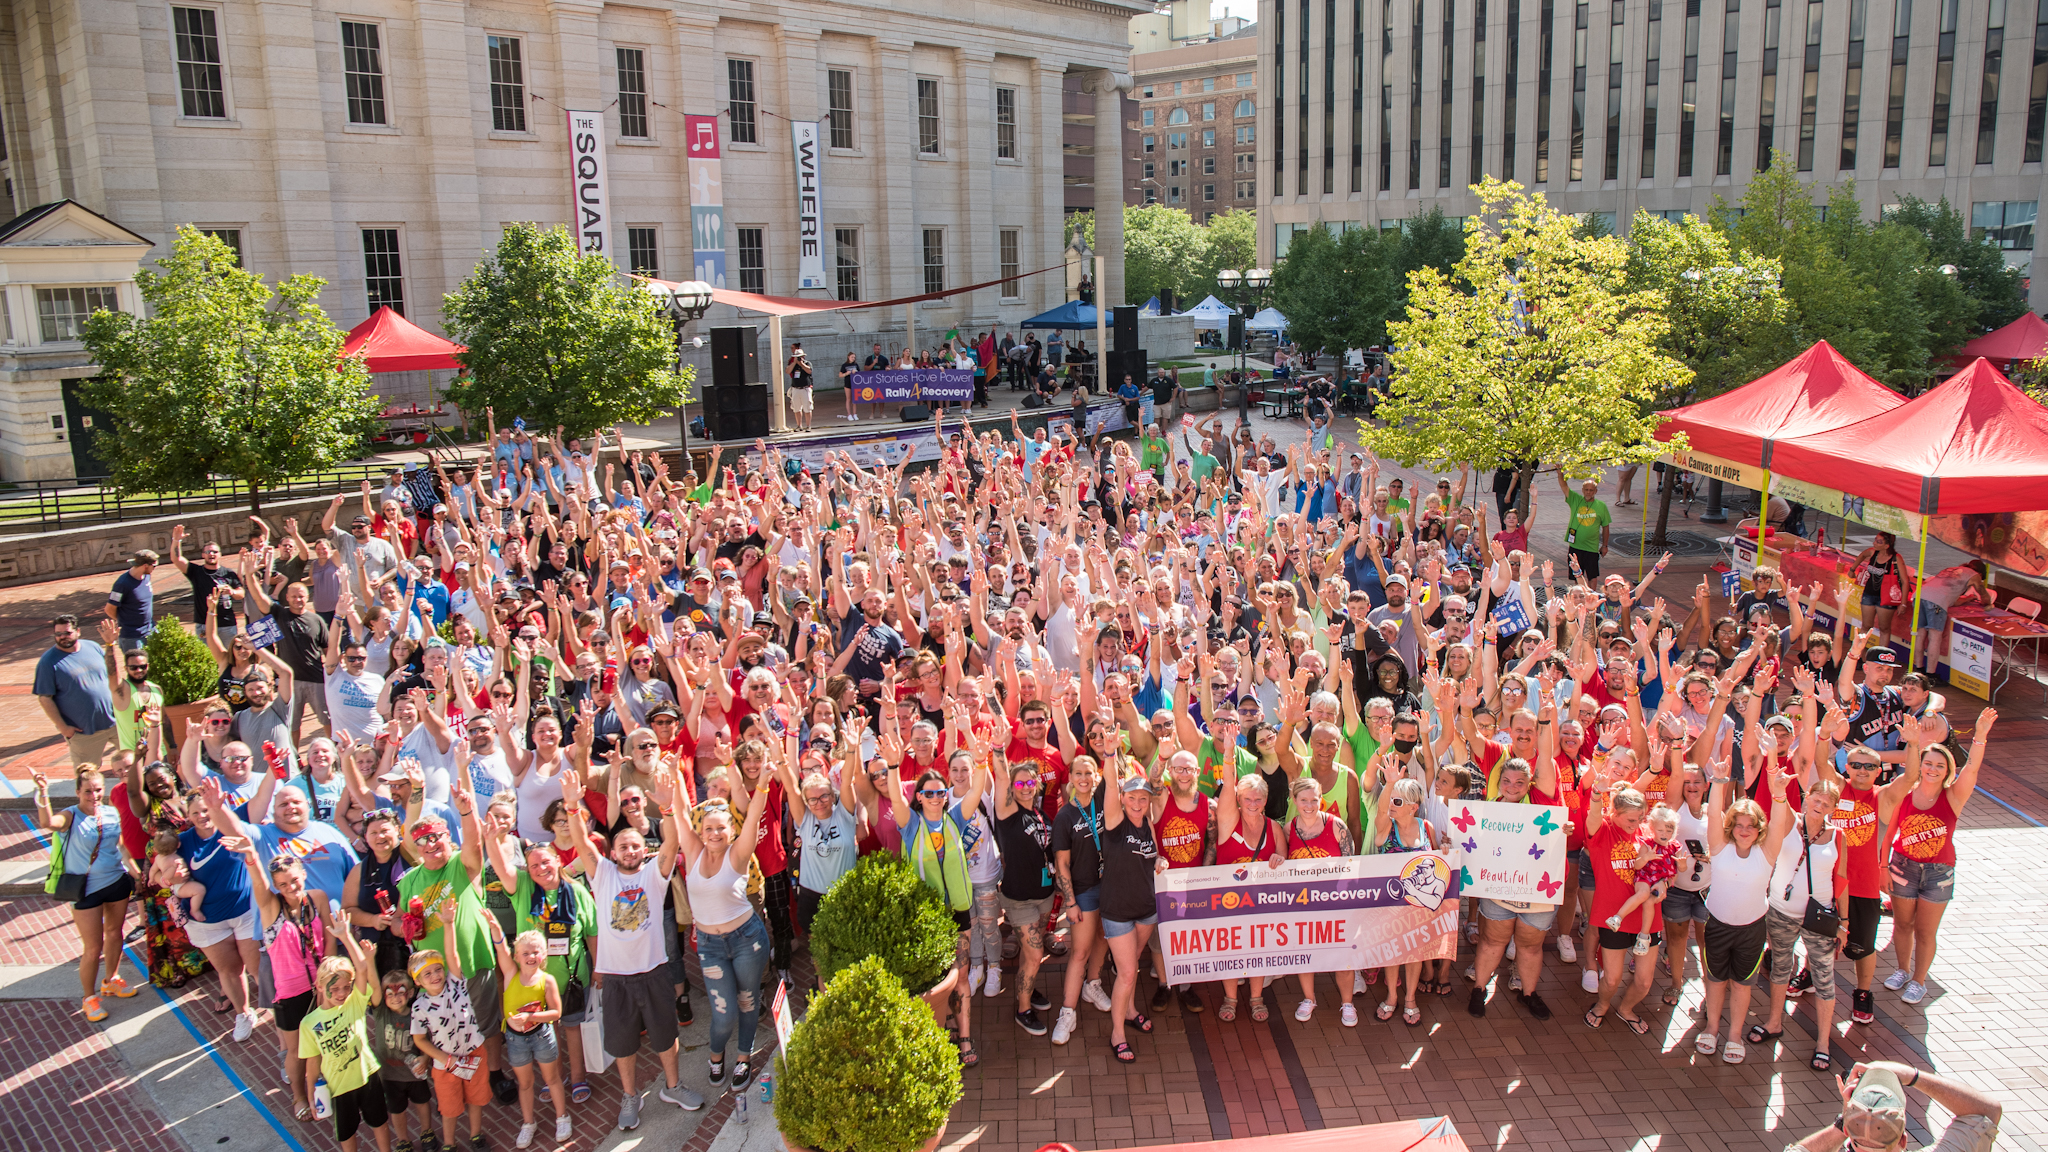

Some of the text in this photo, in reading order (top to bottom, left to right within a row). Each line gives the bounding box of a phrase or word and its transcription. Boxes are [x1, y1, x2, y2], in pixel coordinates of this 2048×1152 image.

[576, 119, 594, 128] THE
[803, 129, 810, 138] IS
[576, 133, 603, 252] SQUAR
[800, 140, 818, 257] WHERE
[853, 371, 972, 385] Our Stories Have Power
[1688, 456, 1713, 474] Canvas
[1713, 465, 1721, 476] of
[1722, 465, 1741, 482] HOPE
[1970, 641, 1985, 653] PATH
[1481, 817, 1525, 834] Recovery
[1919, 830, 1932, 842] IT'S
[1932, 826, 1948, 838] TIME
[1492, 846, 1502, 857] is
[1480, 867, 1529, 886] Beautiful
[1485, 884, 1534, 899] #foarally2021
[1180, 900, 1208, 910] Annual
[1170, 919, 1346, 957] MAYBE IT'S TIME
[1403, 925, 1431, 952] IT'S
[1173, 954, 1312, 977] JOIN THE VOICES FOR RECOVERY
[321, 1023, 355, 1055] FRESH
[333, 1044, 348, 1058] STAY
